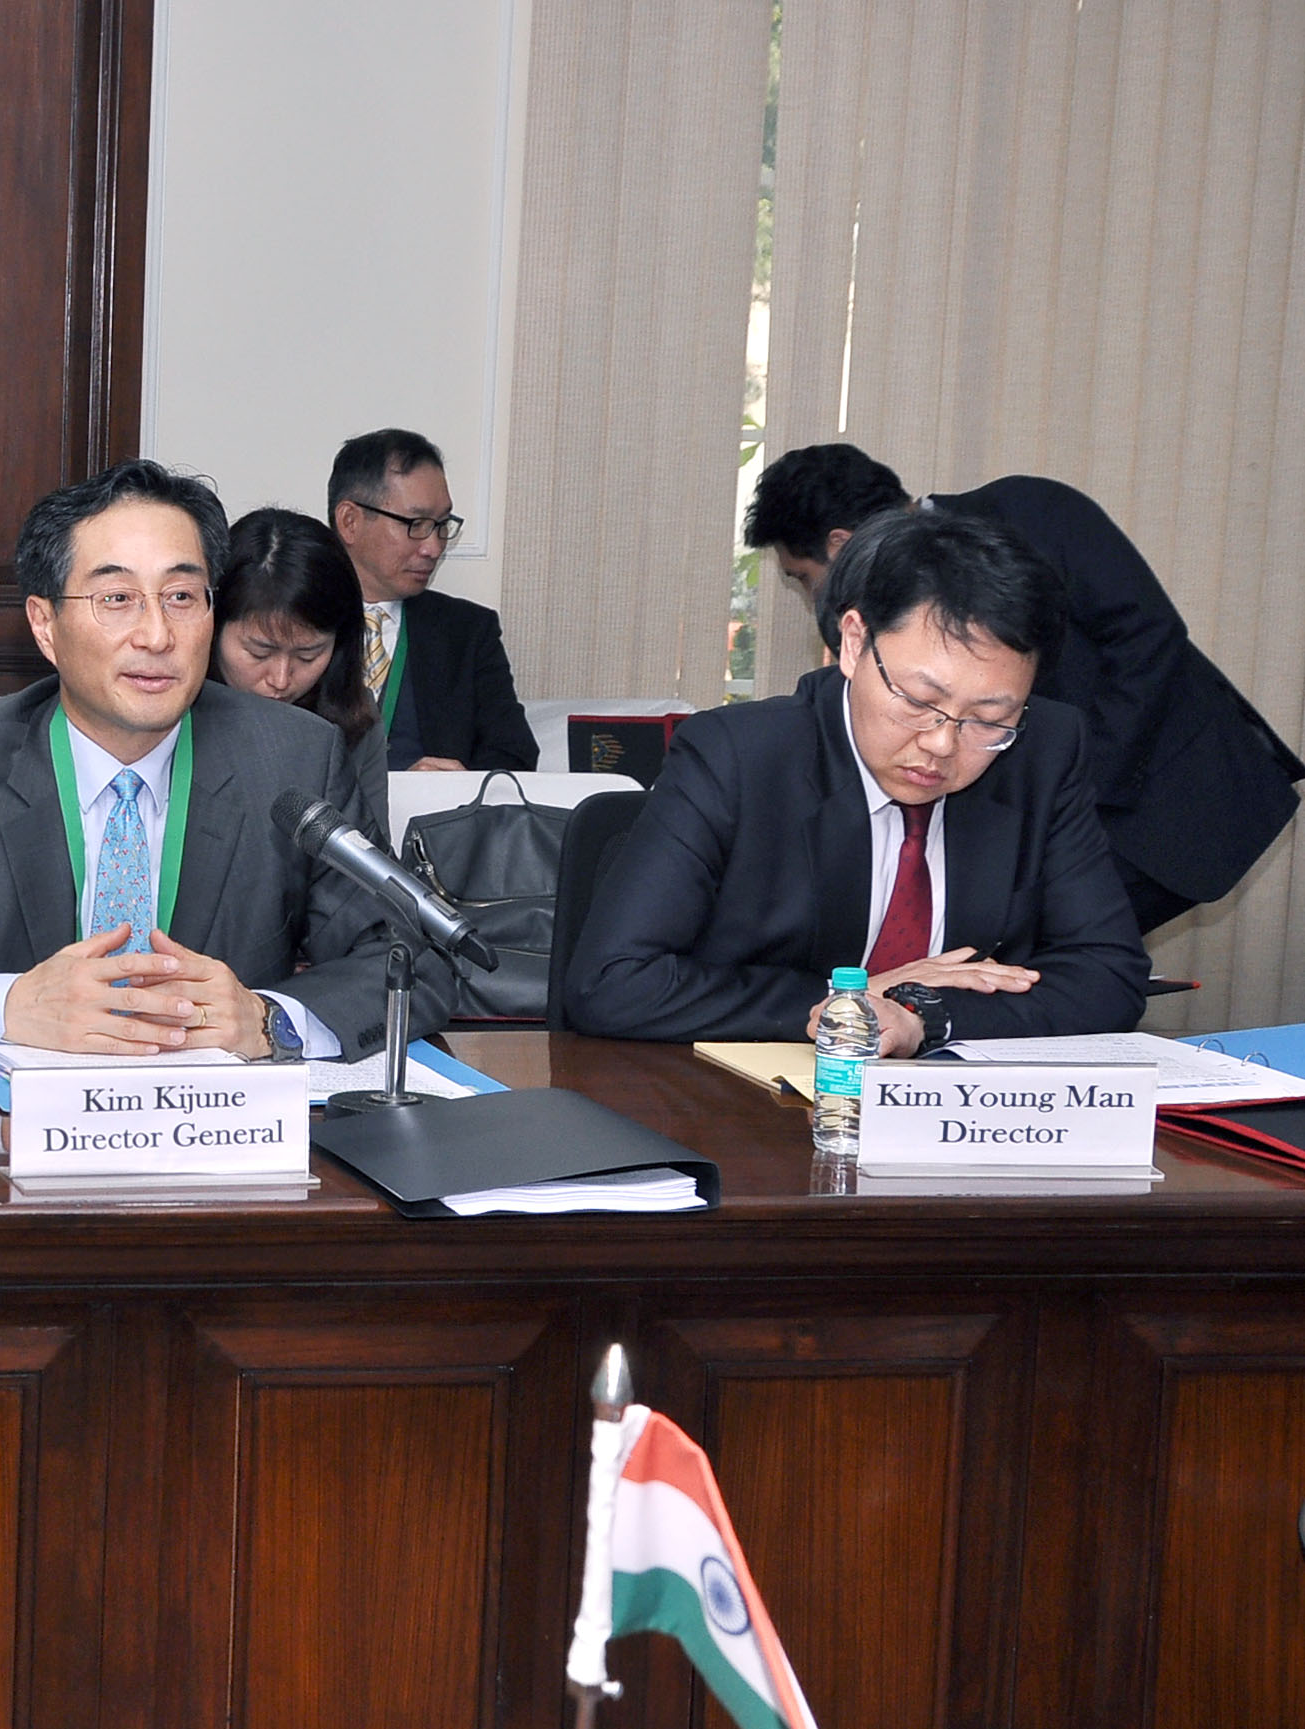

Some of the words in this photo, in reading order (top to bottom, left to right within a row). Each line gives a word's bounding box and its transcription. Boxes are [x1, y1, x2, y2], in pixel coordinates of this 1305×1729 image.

[82, 1088, 143, 1113] Kim
[153, 1085, 246, 1114] Kijune
[876, 1083, 943, 1107] Kim
[953, 1084, 1056, 1113] Young
[1064, 1085, 1135, 1108] Man
[43, 1127, 163, 1152] Director
[173, 1119, 284, 1148] General
[938, 1120, 1069, 1144] Director
